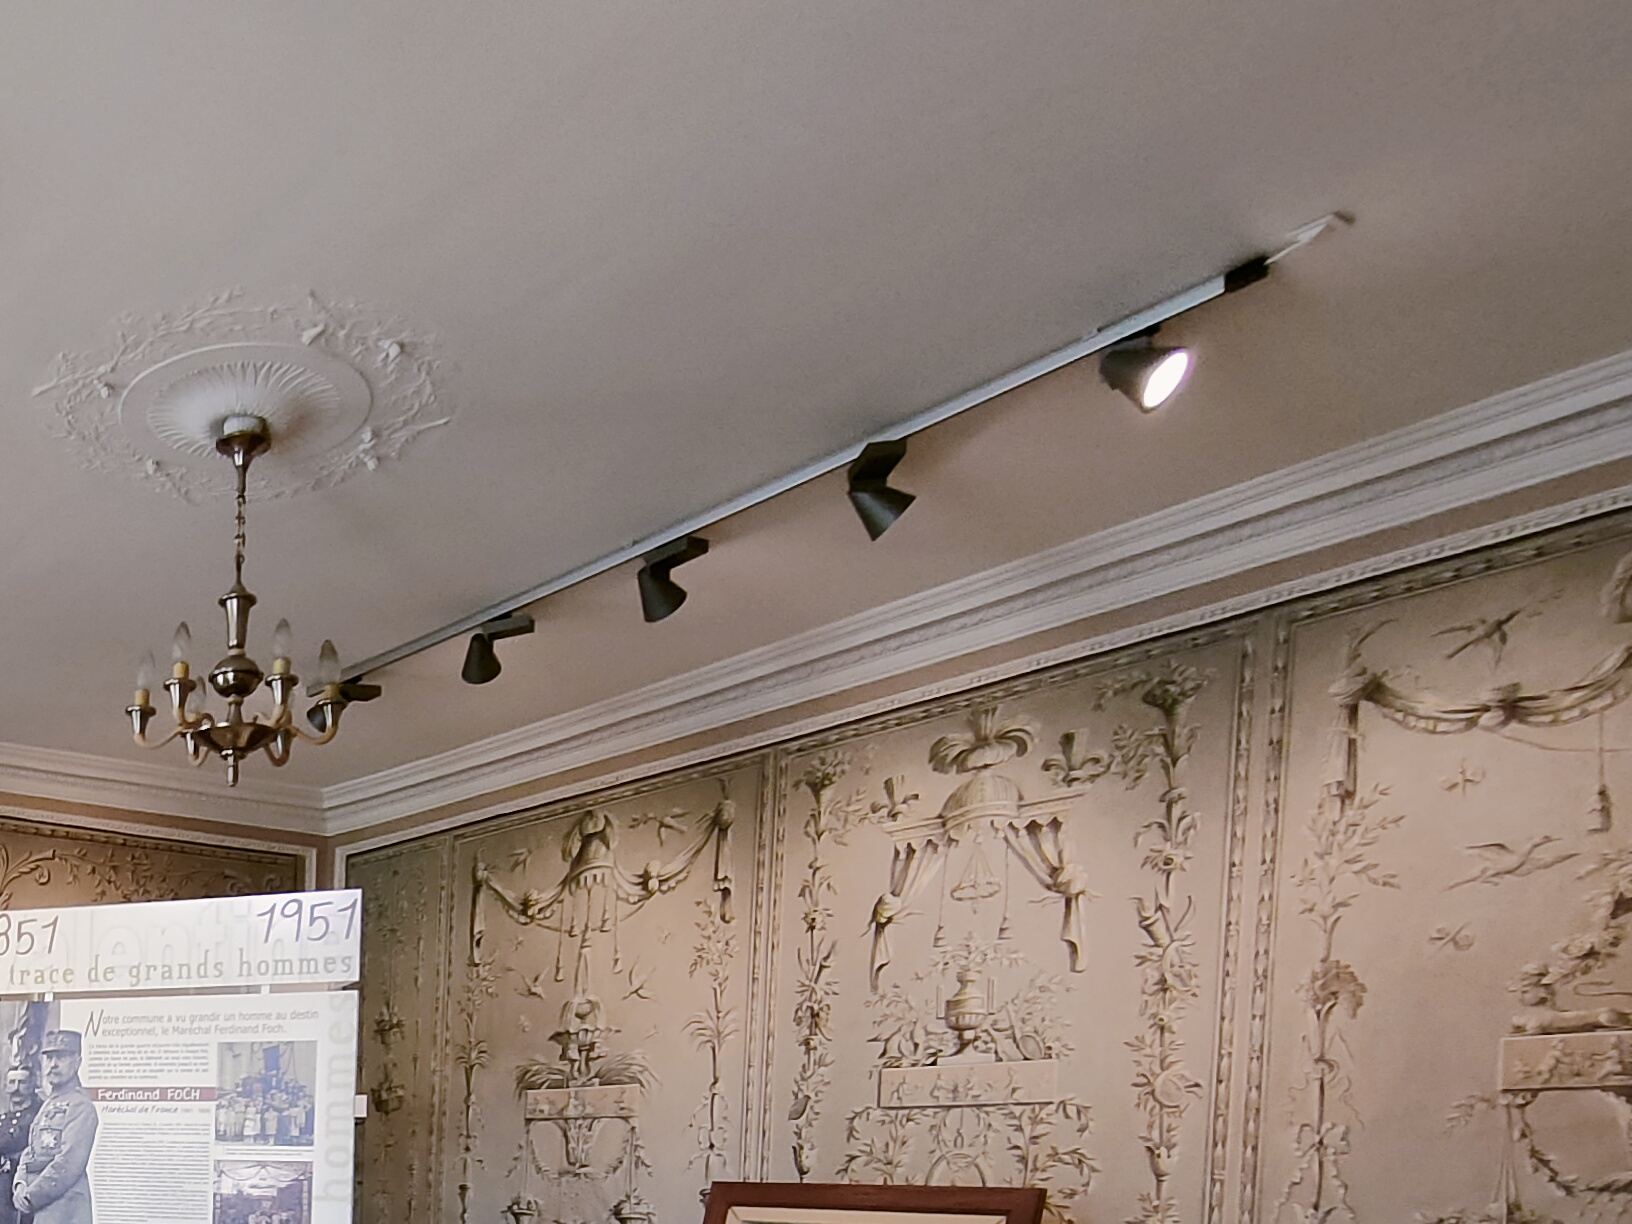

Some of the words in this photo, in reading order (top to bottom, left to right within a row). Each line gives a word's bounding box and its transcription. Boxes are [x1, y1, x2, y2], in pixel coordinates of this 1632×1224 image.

[257, 898, 358, 943] 1951
[9, 964, 74, 985] trace
[88, 954, 115, 983] de
[129, 949, 224, 987] grands
[238, 948, 353, 977] hommes
[122, 1014, 164, 1024] commune
[176, 1014, 186, 1022] vu
[189, 1012, 221, 1025] grandir
[224, 1013, 235, 1021] un
[239, 1011, 272, 1021] homme
[275, 1012, 287, 1020] au
[290, 1010, 318, 1020] destin
[172, 1025, 211, 1036] Maréchal
[214, 1024, 259, 1035] Ferdinand
[98, 1088, 160, 1100] Ferdinand
[167, 1088, 200, 1100] FOCH
